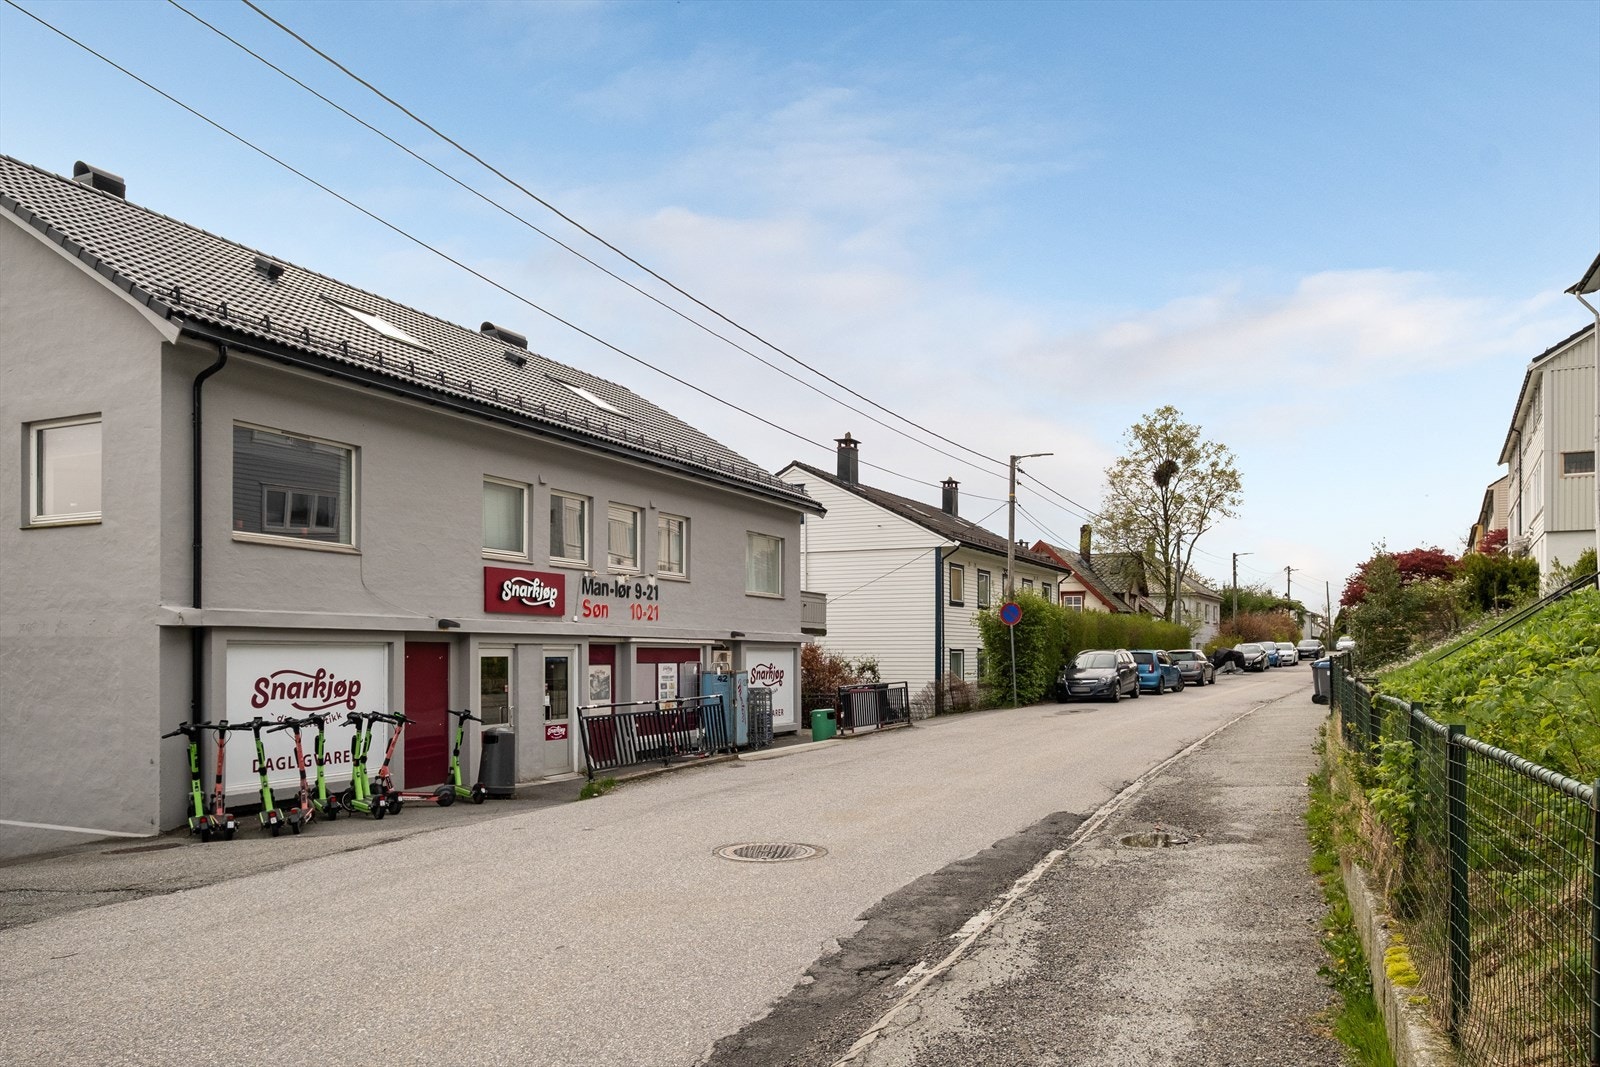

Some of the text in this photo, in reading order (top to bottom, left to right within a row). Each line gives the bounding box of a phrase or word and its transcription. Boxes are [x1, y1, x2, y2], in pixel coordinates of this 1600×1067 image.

[502, 577, 558, 608] Snarkjøp
[635, 583, 658, 601] 9-21
[582, 599, 659, 621] Søn 10-21
[717, 675, 728, 683] 42
[750, 663, 784, 686] Snarkjøp
[251, 668, 361, 709] Snarkjøp
